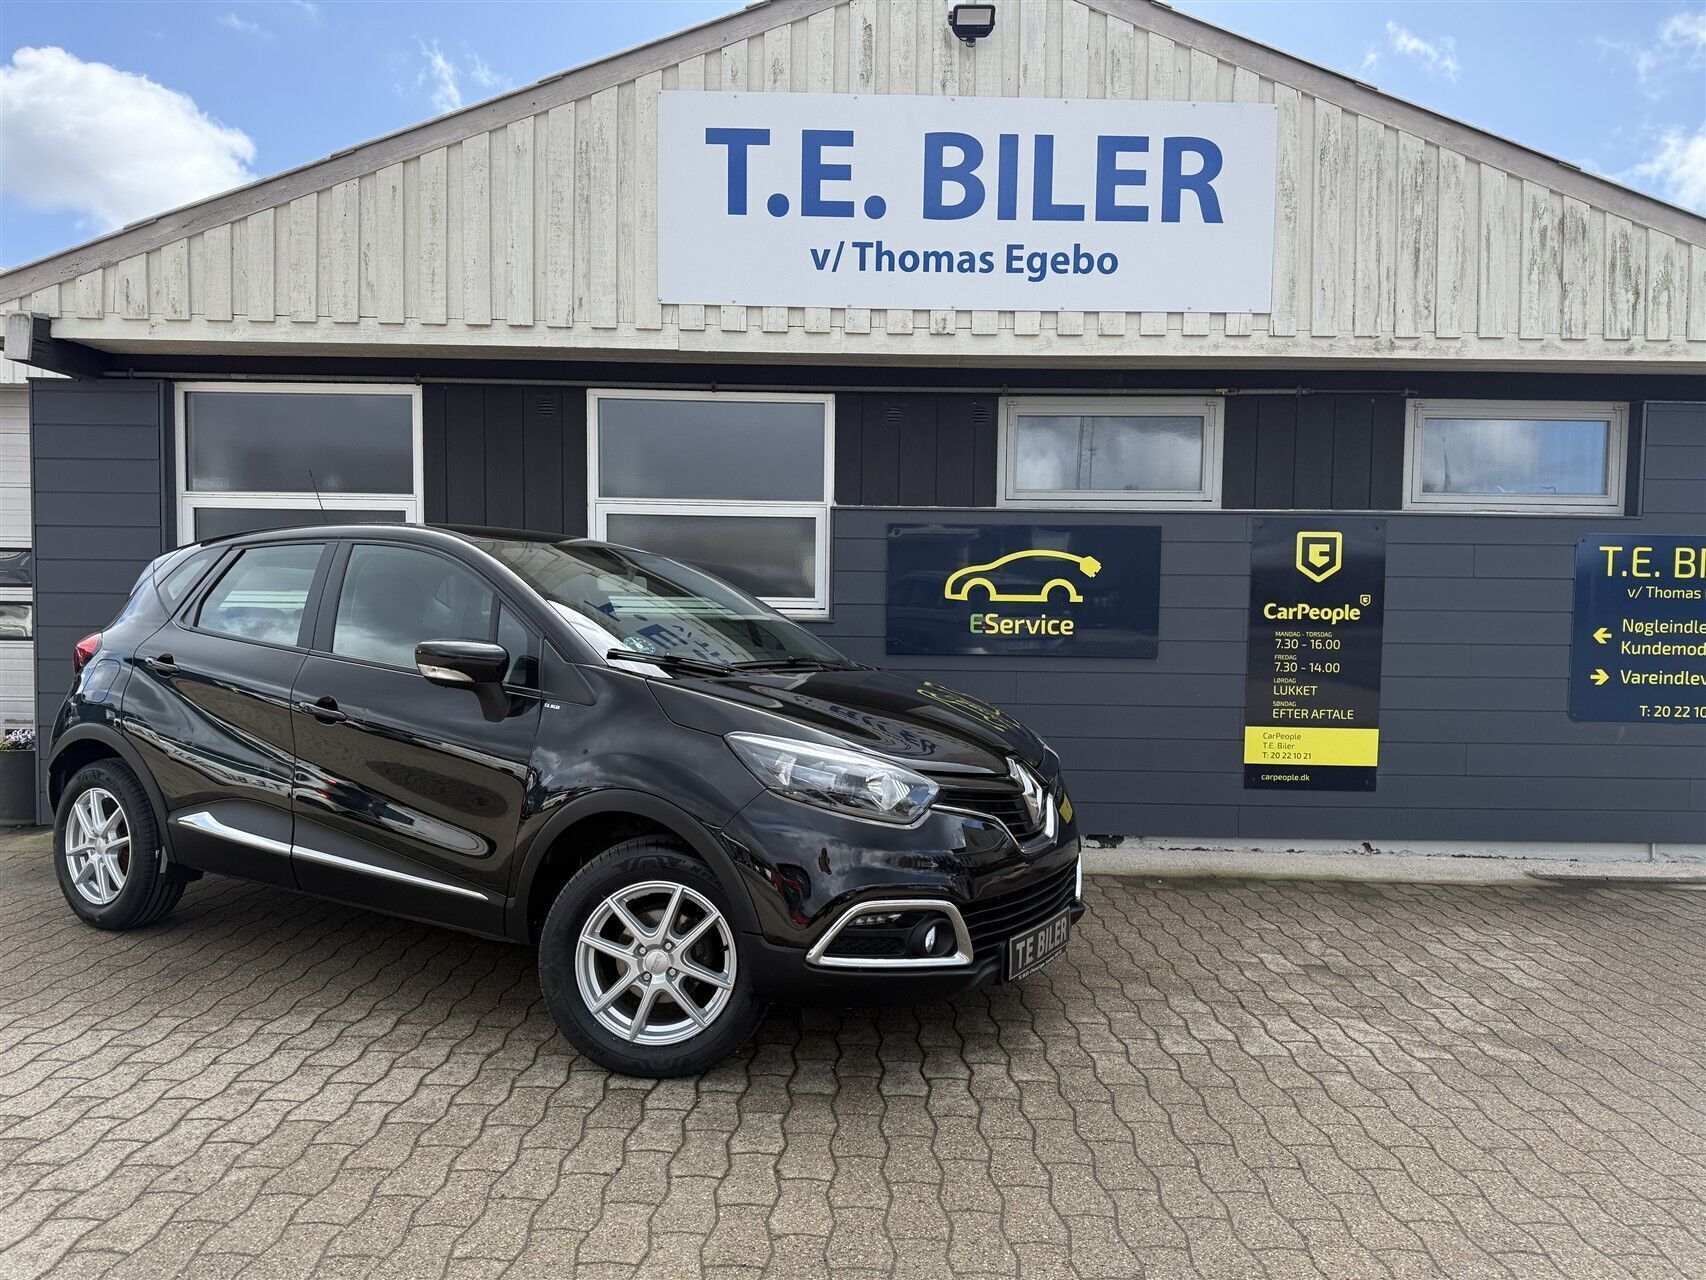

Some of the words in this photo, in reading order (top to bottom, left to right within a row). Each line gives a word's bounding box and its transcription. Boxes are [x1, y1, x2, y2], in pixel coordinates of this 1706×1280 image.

[705, 127, 887, 221] T.E.
[922, 131, 1225, 224] BILER
[809, 242, 845, 274] v/
[852, 241, 995, 275] Thomas
[1005, 244, 1120, 283] Egebo
[1599, 546, 1660, 578] T.E.
[1674, 547, 1706, 579] BI
[1627, 586, 1643, 599] v/
[1646, 586, 1702, 600] Thomas
[1263, 602, 1361, 625] CarPeople
[970, 613, 1075, 636] EService
[1622, 618, 1706, 637] Nøgleindle
[1275, 638, 1299, 649] 7.30
[1310, 639, 1341, 650] 16.00
[1621, 640, 1706, 656] Kundemod
[1274, 661, 1298, 673] 7.30
[1309, 662, 1340, 673] 14.00
[1273, 685, 1318, 696] LUKKET
[1272, 708, 1309, 719] EFTER
[1310, 709, 1354, 720] AFTALE
[1639, 705, 1651, 717] T:
[1653, 705, 1671, 718] 20
[1674, 706, 1691, 718] 22
[1694, 706, 1706, 718] 10
[1262, 732, 1302, 741] CarPeople
[1262, 741, 1275, 749] T.E.
[1277, 742, 1295, 750] Biler
[1262, 751, 1269, 759] T:
[1270, 751, 1281, 760] 20
[1282, 751, 1292, 760] 22
[1293, 752, 1302, 760] 10
[1303, 752, 1312, 760] 21
[1260, 773, 1310, 782] carpeople.dk
[1016, 935, 1035, 970] TE
[1036, 916, 1068, 959] BILER
